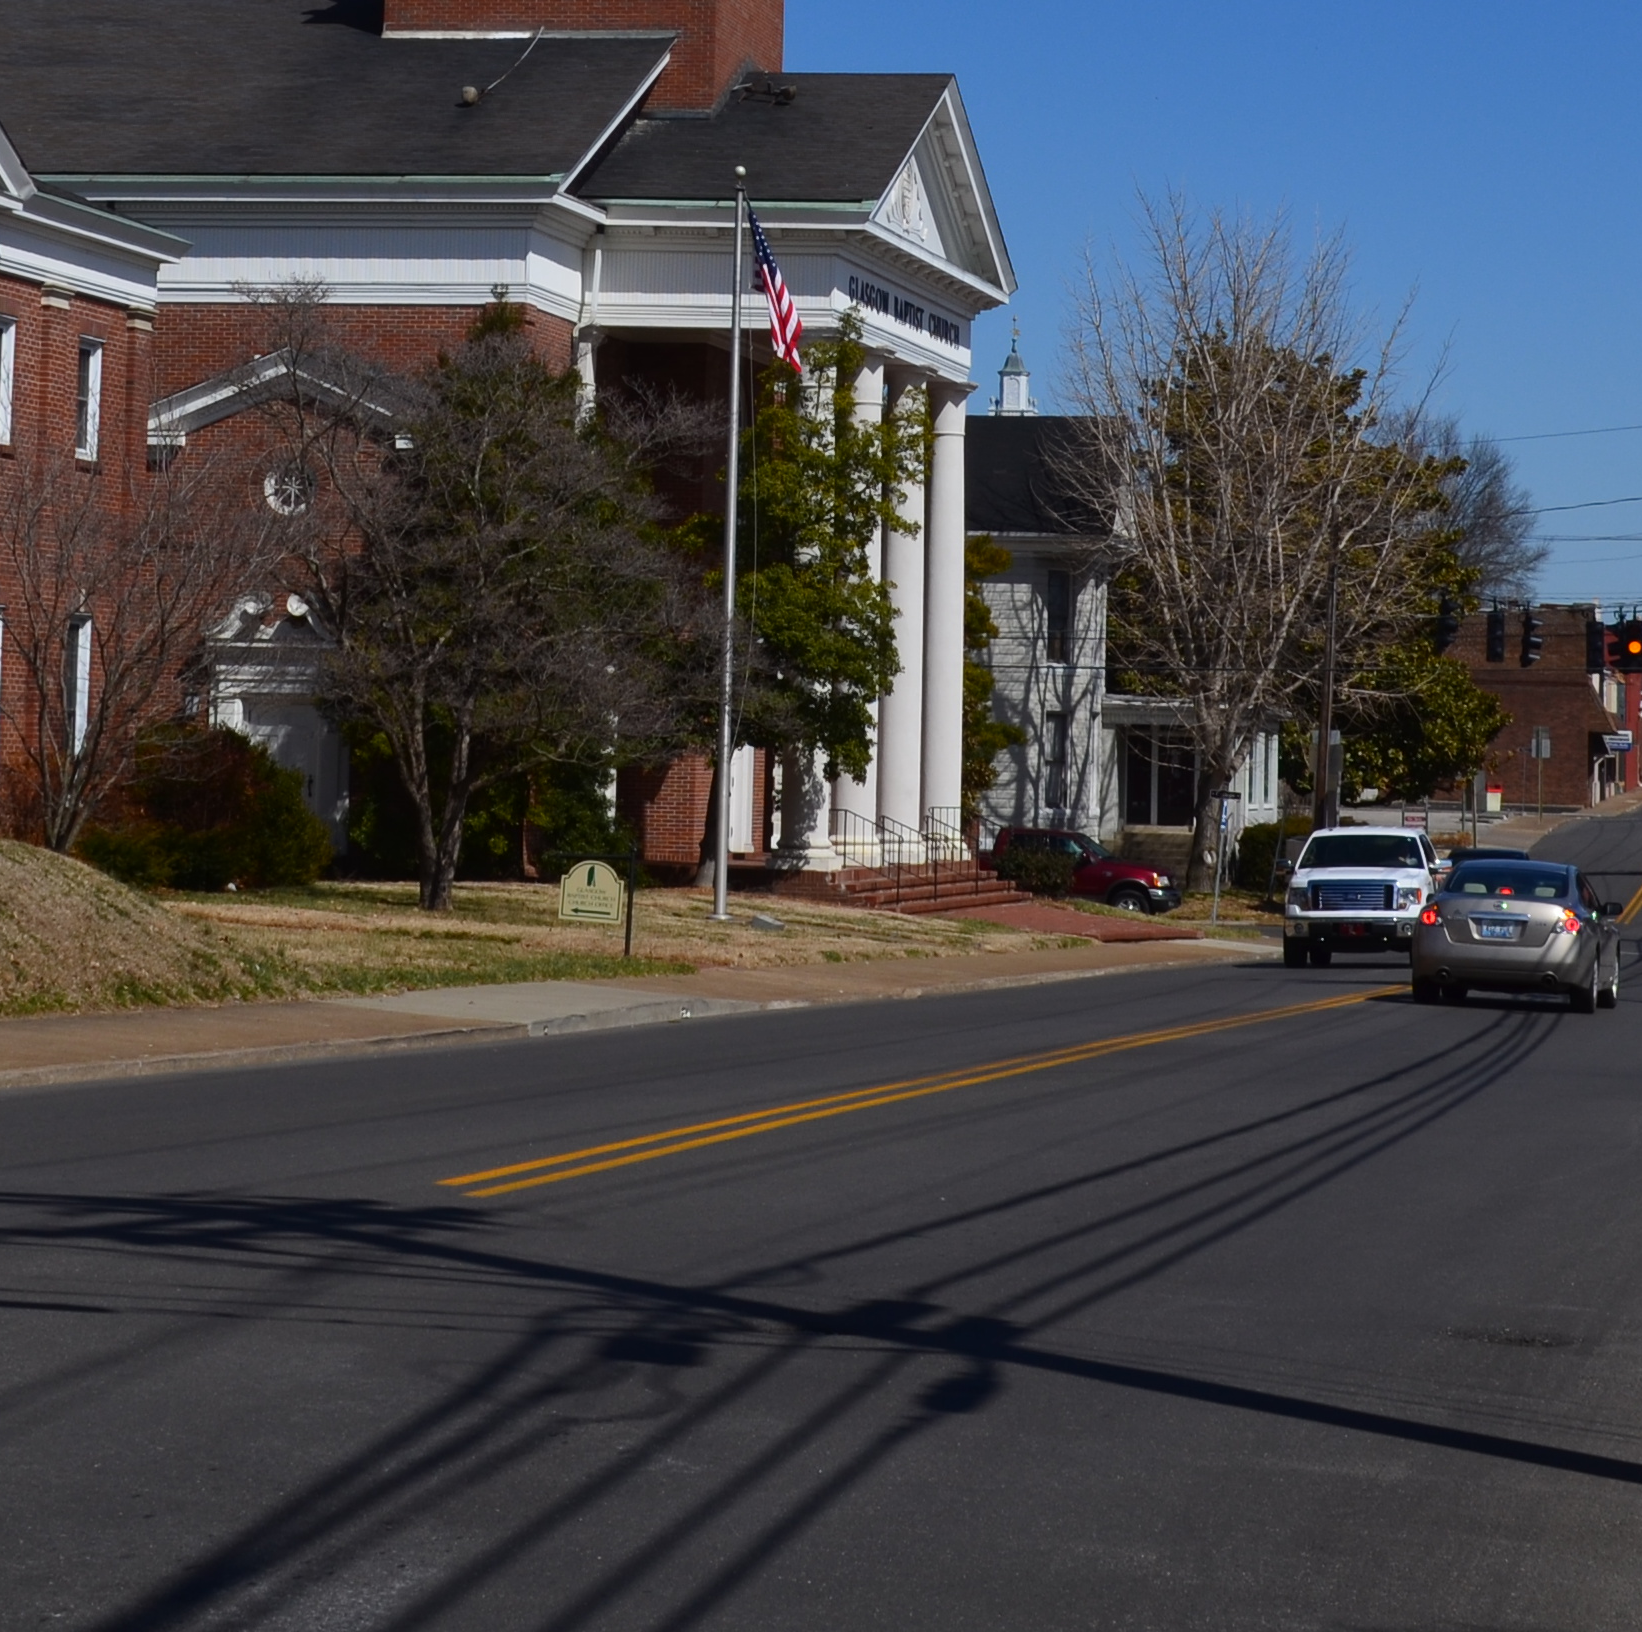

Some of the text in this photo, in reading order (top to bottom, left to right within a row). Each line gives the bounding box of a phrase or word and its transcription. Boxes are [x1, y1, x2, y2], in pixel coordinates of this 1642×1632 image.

[848, 275, 960, 350] GLASGOW BAPTIST CHURCH
[576, 886, 606, 894] GLASGOW
